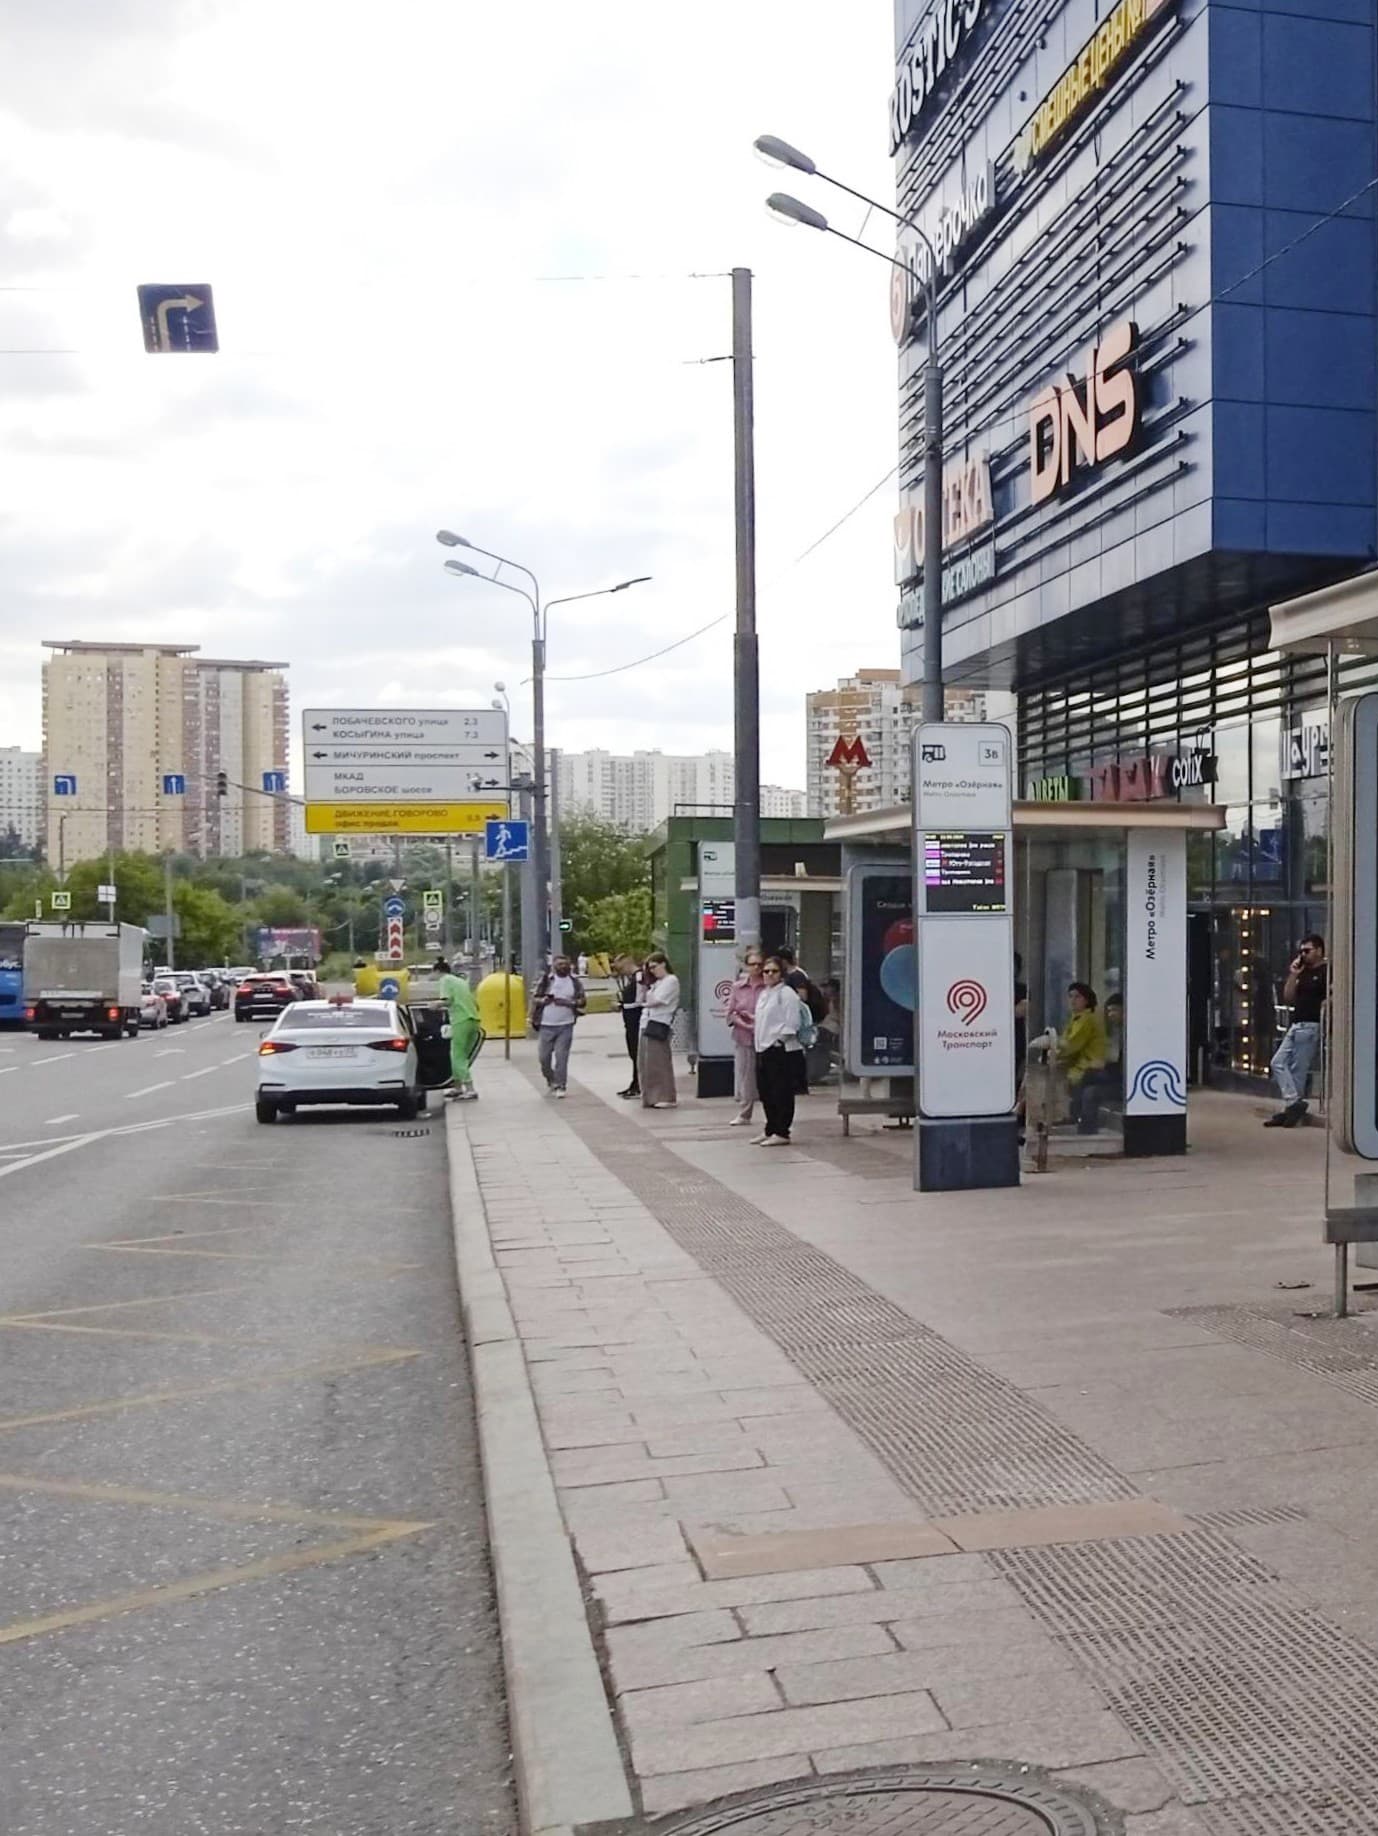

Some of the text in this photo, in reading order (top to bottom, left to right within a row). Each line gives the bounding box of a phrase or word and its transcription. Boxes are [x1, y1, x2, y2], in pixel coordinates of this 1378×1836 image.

[1030, 321, 1137, 506] DNS
[332, 716, 449, 727] ЛОБАЧЕВСКОГО улица
[333, 730, 425, 740] КОСЫГИНА улица
[333, 750, 460, 761] МИЧУРИНСКИЙ проспект
[334, 772, 364, 781] МКАД
[334, 786, 398, 795] БОРОВСКОЕ
[1145, 920, 1157, 960] Метро
[938, 1029, 998, 1039] Московский
[942, 1040, 993, 1051] Транспорт
